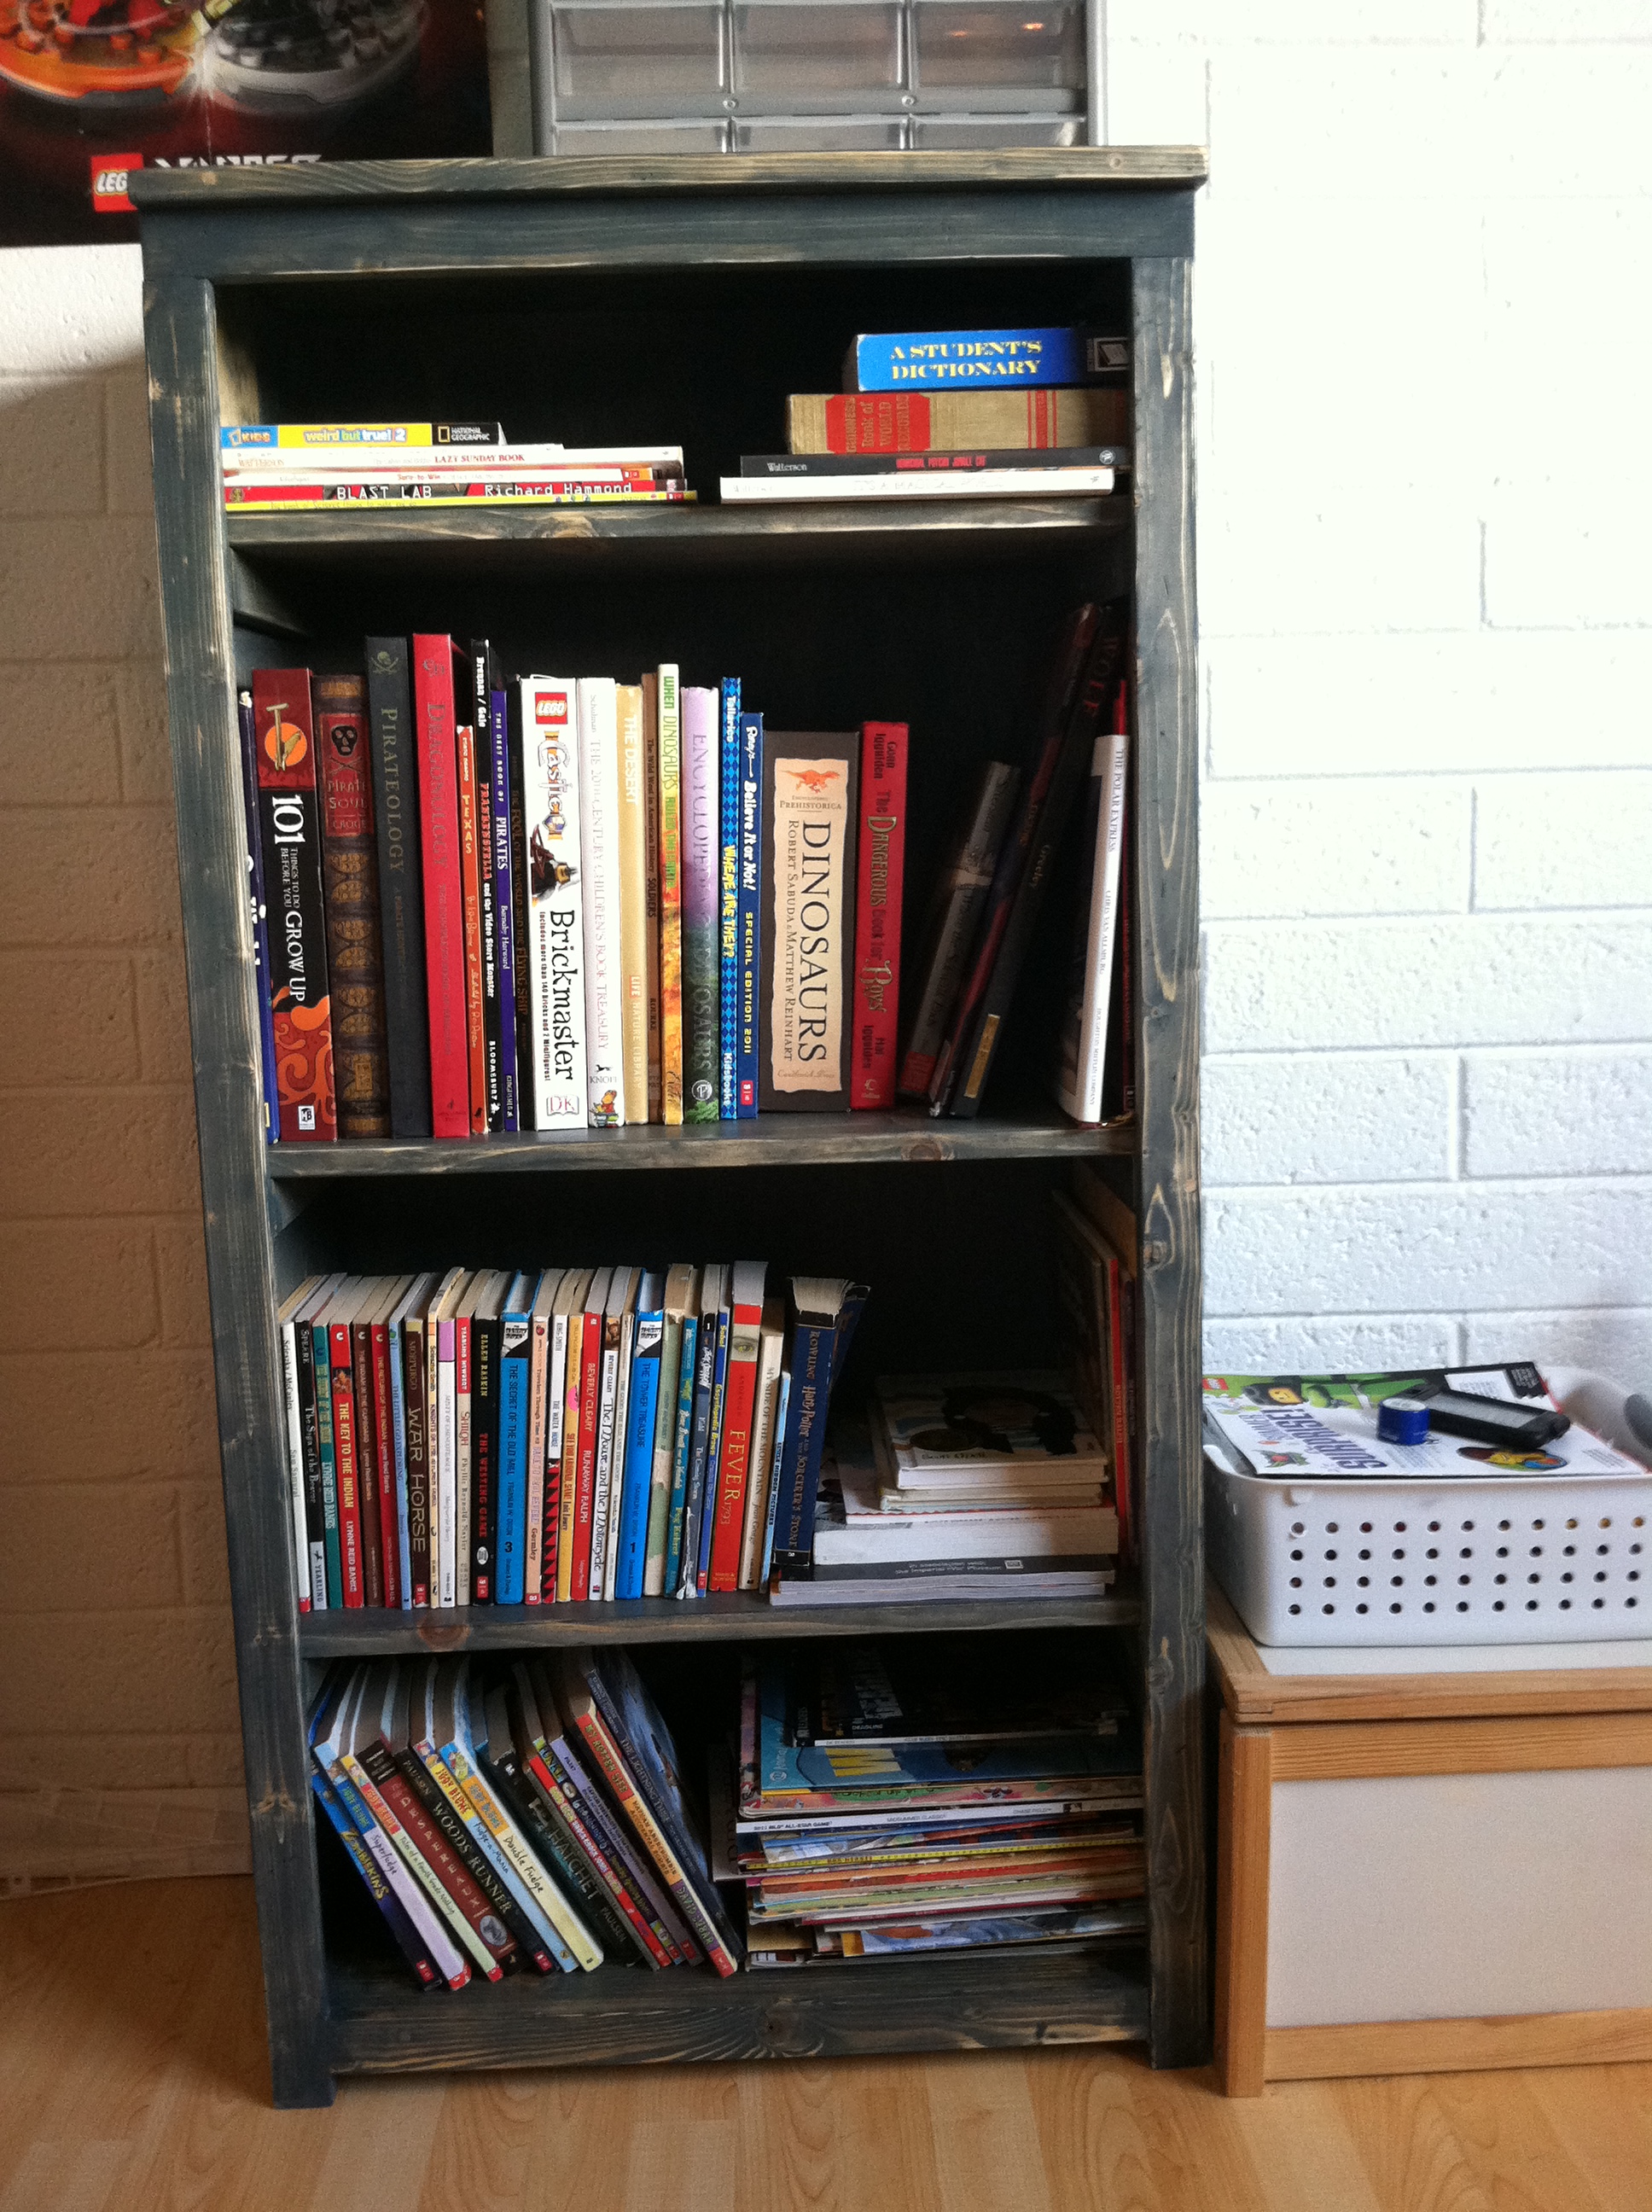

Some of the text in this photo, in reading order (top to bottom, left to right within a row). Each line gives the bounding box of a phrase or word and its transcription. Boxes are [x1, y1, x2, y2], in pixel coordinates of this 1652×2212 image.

[96, 172, 128, 193] LEG
[890, 341, 1042, 359] A STUDENT'S
[892, 359, 1041, 380] DICTIONARY
[305, 427, 409, 444] weird but true! 2
[434, 456, 461, 464] LAZY
[462, 454, 497, 463] SUNDAY
[860, 418, 875, 448] Book
[879, 401, 893, 447] WORLD
[336, 481, 633, 501] BLAST LAB Richard Hammond
[475, 655, 486, 696] Brennan
[476, 707, 488, 729] Gale
[662, 675, 679, 790] WHEN DINOSAURS
[329, 797, 367, 810] SOUL
[380, 707, 404, 873] PIRATEOLOGY
[427, 701, 448, 870] DRAGONOLOGY
[461, 795, 474, 854] TEXAS
[779, 800, 842, 810] PREHISTORICA
[496, 816, 509, 870] PIRATES
[866, 816, 898, 907] DANGEROUS
[1104, 749, 1126, 915] THE POLAR EXPRESS CHRIS
[272, 794, 306, 1003] 101 GROW UP
[280, 847, 292, 908] BEFORE YOU
[289, 847, 301, 909] THINGS TO DO
[590, 739, 609, 1050] THE CHILDREN'S BOOK TREASURY
[625, 713, 643, 1089] THE DESERT LIFE NATURE LIBRARY
[648, 876, 658, 918] SOLDIERS
[742, 780, 759, 1055] Believe It Not! SPECIAL EDITION 2011
[486, 962, 497, 998] Monster
[721, 844, 737, 1107] WHERE THEY? Kidsbooks
[783, 819, 800, 1062] ROBERT SABUDA MATTHEW REINHART
[798, 819, 832, 1062] DINOSAURS
[550, 910, 580, 1080] Brickmaster
[489, 1039, 498, 1099] BLOOMSBURY
[550, 1095, 575, 1112] DK
[409, 1339, 426, 1553] MORPURGO WAR HORSE
[459, 1411, 471, 1485] SHILOH Phyllis
[478, 1334, 489, 1539] ELLEN RASKIN THE WESTING GAME
[550, 1412, 561, 1448] WATER HORSE
[579, 1362, 596, 1523] BEVERLY CLEARY RUNAWAY RALPH
[635, 1363, 653, 1448] THE TOWER TREASURE
[754, 1383, 775, 1496] SIDE OF THE MOUNTAIN
[787, 1330, 822, 1549] ROWLING Harry Potter SORCERER'S STONE
[300, 1329, 324, 1604] SPEARE The Sign YEARLING
[339, 1401, 358, 1592] THE KEY TO THE INDIAN LYNNE REID BANKS
[503, 1365, 519, 1554] THE SECRET THE 3
[592, 1398, 614, 1573] The Mouse and the Motorcycle
[719, 1429, 747, 1526] FEVER 1793
[529, 1527, 539, 1562] Gormley
[370, 1833, 399, 1877] Superfudge
[433, 1802, 472, 1855] WOODS
[468, 1855, 514, 1914] RUNNER
[502, 1835, 546, 1895] Double Fudge
[549, 1821, 598, 1901] HATCHET
[601, 1905, 629, 1945] PAULSEN
